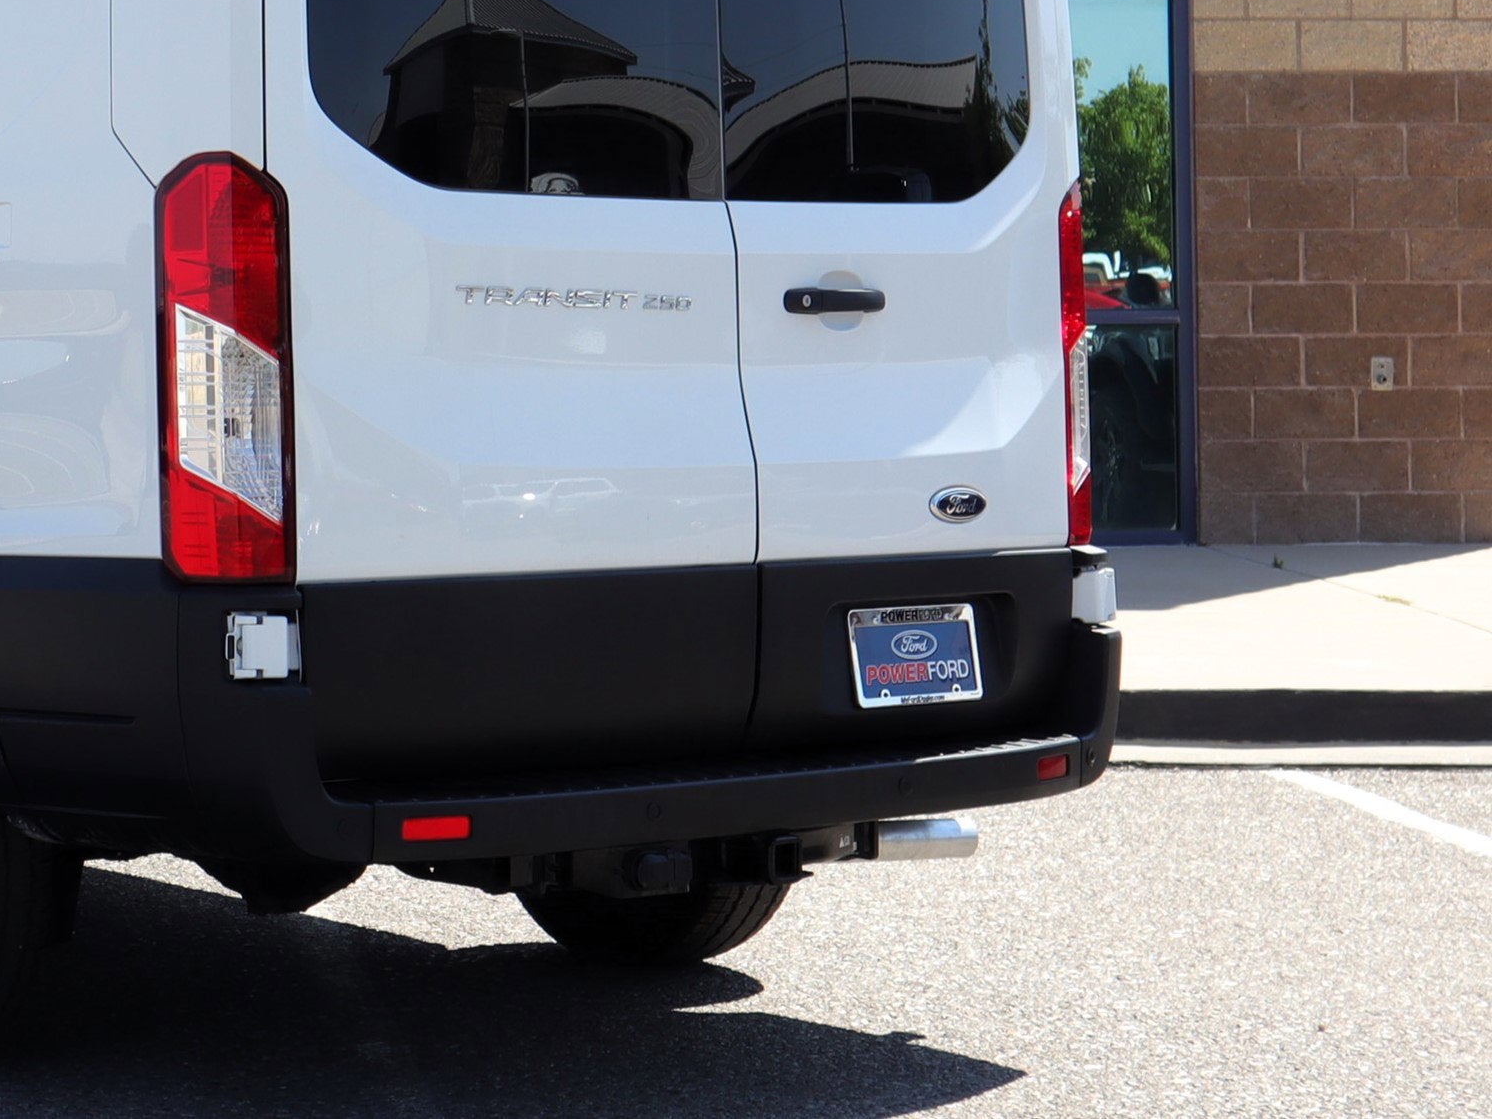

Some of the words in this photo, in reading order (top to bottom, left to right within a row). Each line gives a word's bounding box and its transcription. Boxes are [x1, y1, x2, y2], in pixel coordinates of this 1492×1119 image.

[456, 285, 638, 310] TRANSIT
[642, 294, 692, 312] 250
[946, 494, 977, 514] Ford
[901, 635, 929, 654] Ford
[866, 658, 969, 685] POWERFORD
